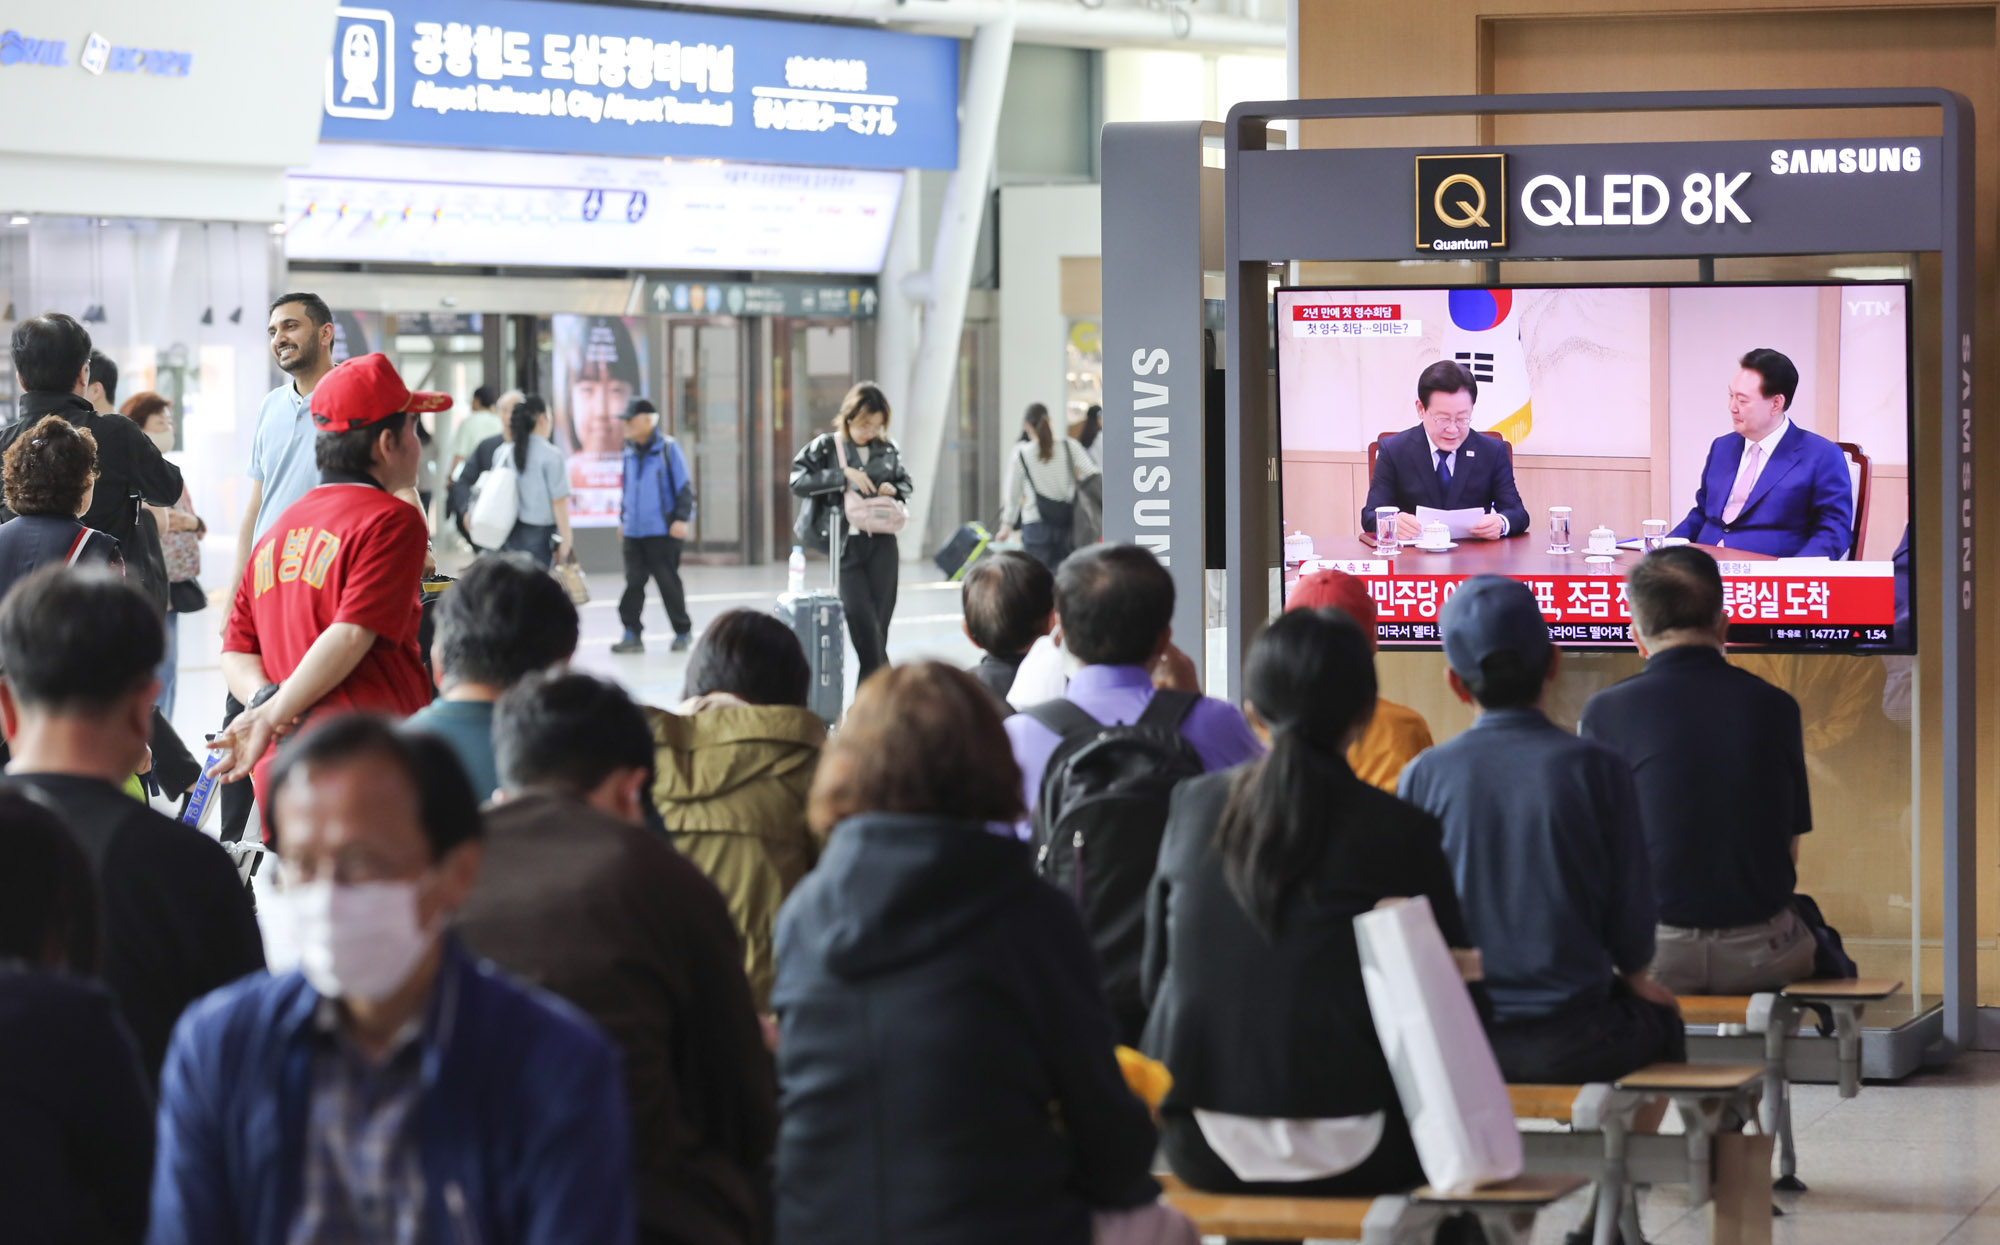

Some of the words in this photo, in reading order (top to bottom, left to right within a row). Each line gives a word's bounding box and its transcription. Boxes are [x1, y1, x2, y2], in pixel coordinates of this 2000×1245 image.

[411, 22, 533, 80] 공항철도
[540, 34, 734, 93] 도심공항터미널
[1770, 147, 1922, 175] SAMSUNG
[1521, 174, 1670, 226] QLED
[1681, 172, 1752, 225] 8K
[1433, 238, 1489, 251] Quantum
[1302, 307, 1319, 319] 2년
[1320, 307, 1340, 319] 만에
[1342, 306, 1352, 319] 첫
[1353, 306, 1393, 319] 영수회담
[1846, 301, 1891, 317] YTN
[1308, 323, 1318, 335] 첫
[1319, 323, 1340, 335] 영수
[1131, 348, 1171, 567] SAMSUN
[1961, 333, 1972, 610] SAMSUNG
[1718, 562, 1752, 575] 통령실
[1366, 580, 1438, 617] 민주당
[1523, 580, 1563, 621] 표,
[1566, 581, 1611, 617] 조금
[1721, 581, 1780, 619] 통령실
[1784, 581, 1829, 619] 도착
[1377, 625, 1410, 638] 미국서
[1589, 625, 1623, 639] 떨어져
[1810, 629, 1850, 639] 1477.17
[1865, 629, 1887, 639] 1.54
